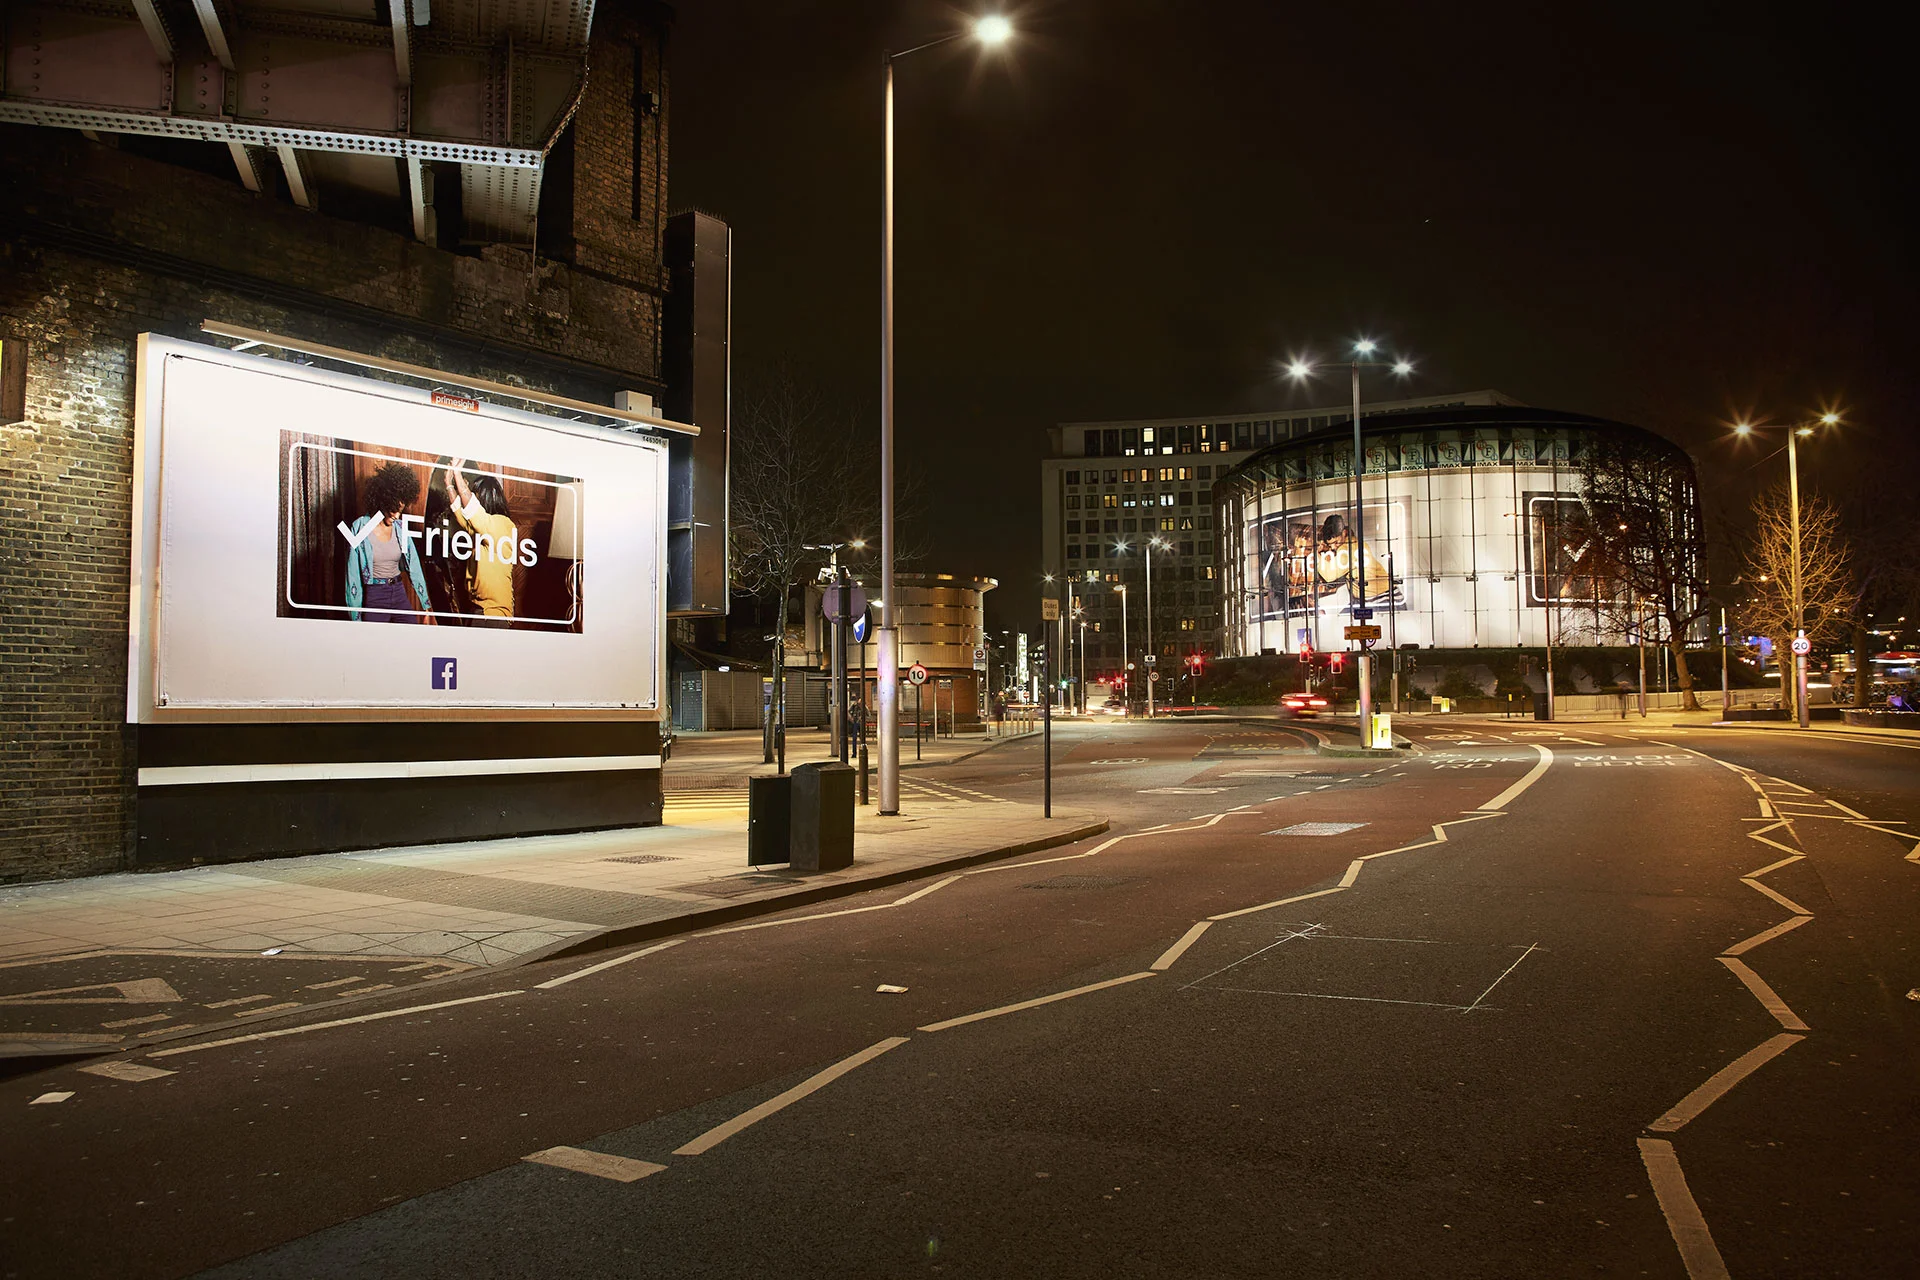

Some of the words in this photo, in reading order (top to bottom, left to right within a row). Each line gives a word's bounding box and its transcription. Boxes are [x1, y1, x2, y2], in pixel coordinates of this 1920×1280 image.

[435, 395, 475, 409] primesight
[401, 513, 538, 567] Friends
[1794, 642, 1808, 650] 20
[911, 670, 924, 680] 10
